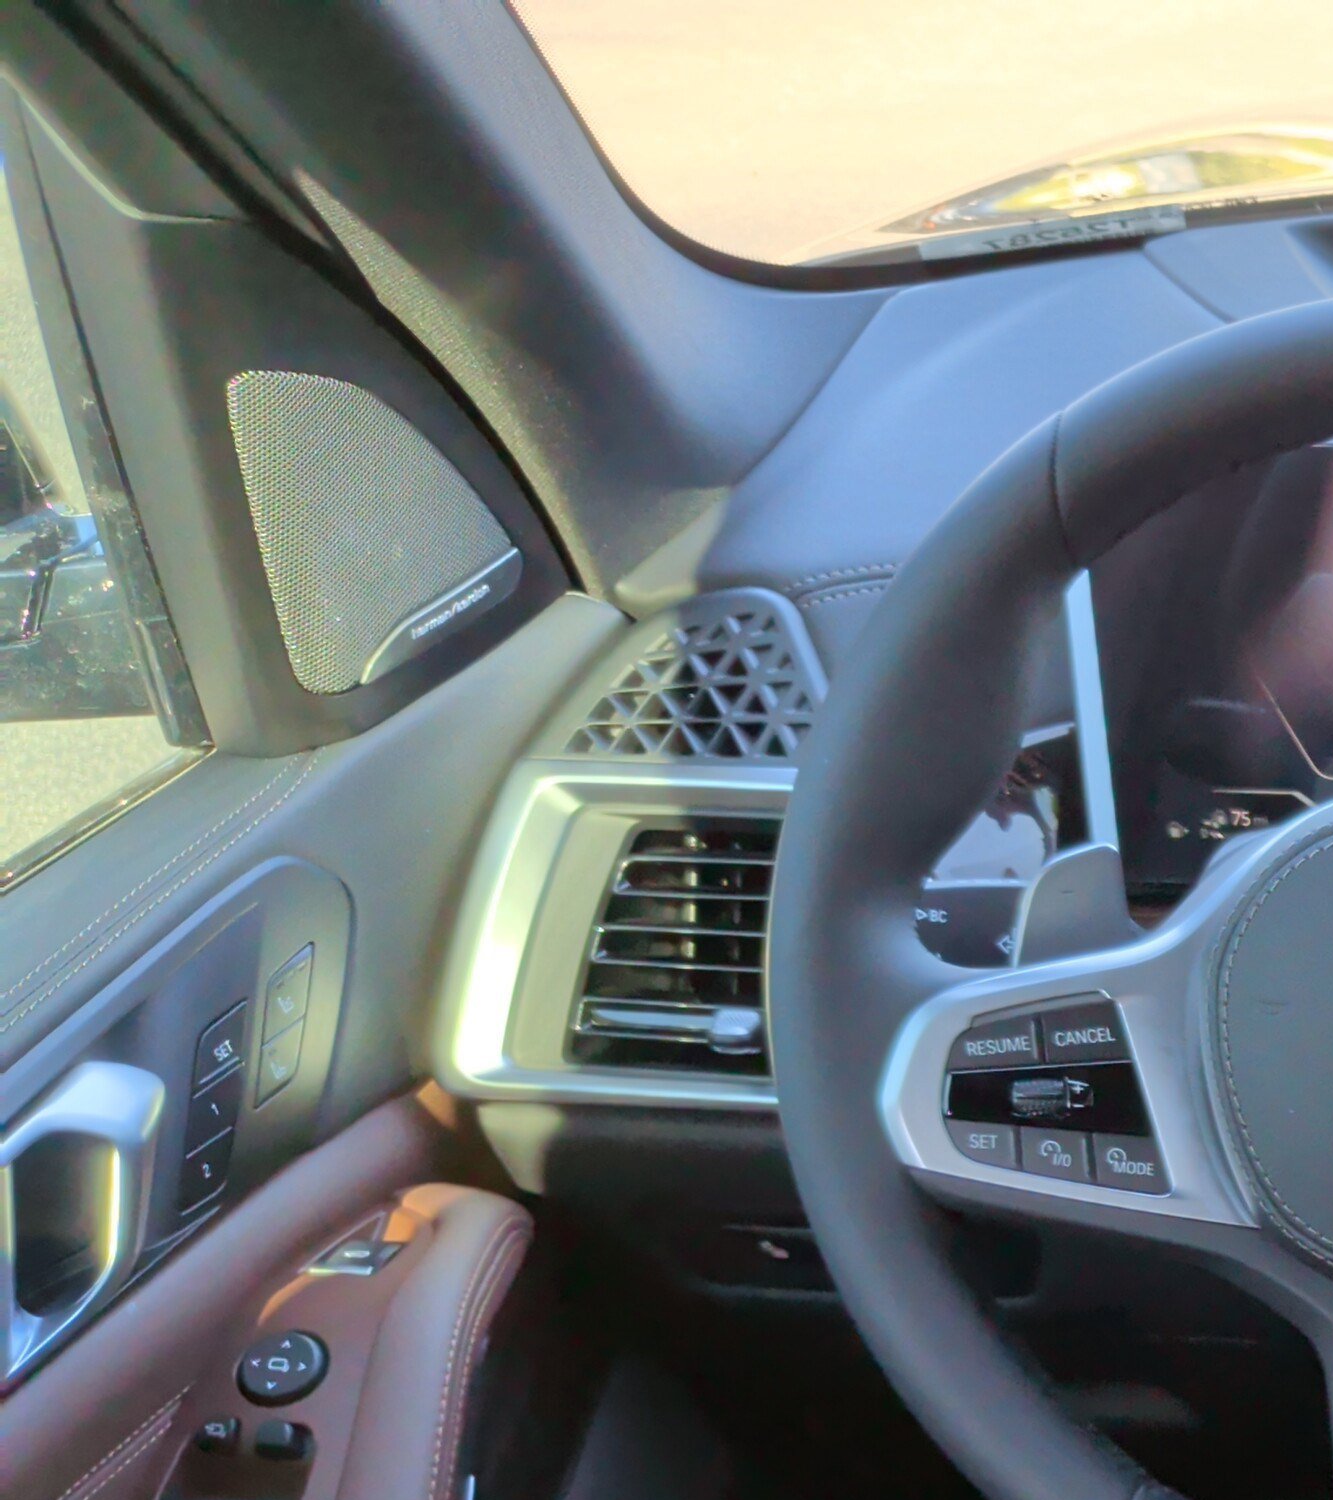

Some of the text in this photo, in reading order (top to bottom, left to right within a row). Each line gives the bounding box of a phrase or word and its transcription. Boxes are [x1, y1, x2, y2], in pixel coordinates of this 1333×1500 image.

[1230, 809, 1251, 826] 75
[1055, 1027, 1116, 1047] CANCEL
[212, 1038, 233, 1062] SET
[966, 1036, 1031, 1057] RESUME
[210, 1103, 219, 1117] 1
[970, 1134, 998, 1150] SET
[201, 1163, 211, 1178] 2
[1112, 1161, 1155, 1177] MODE
